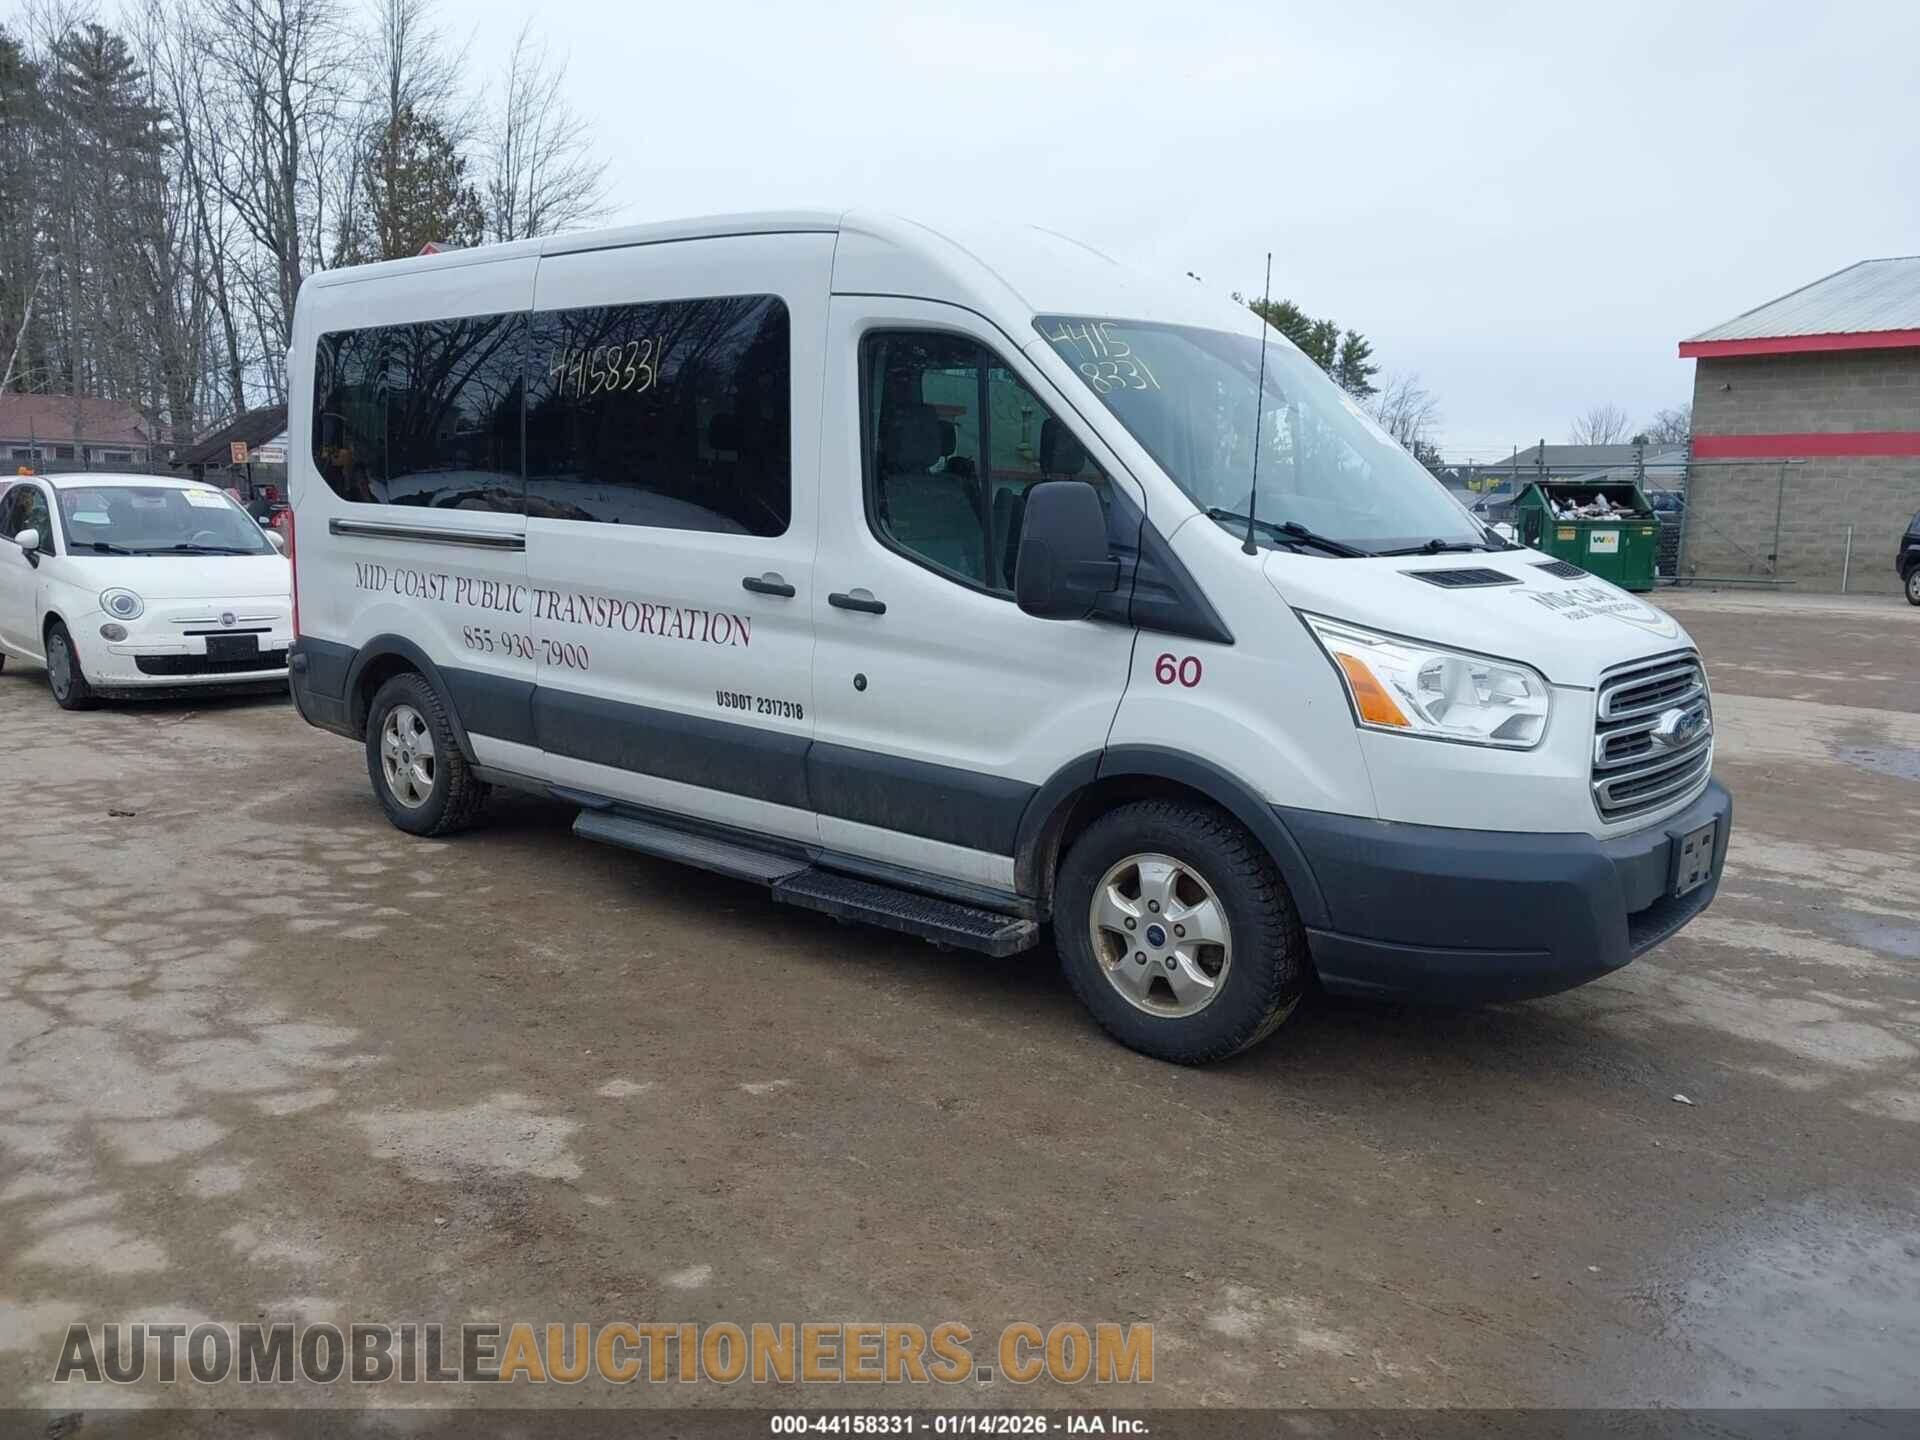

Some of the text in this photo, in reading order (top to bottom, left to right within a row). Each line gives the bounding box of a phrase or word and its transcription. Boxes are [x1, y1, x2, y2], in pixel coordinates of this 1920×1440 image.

[1039, 322, 1130, 359] 4415
[549, 335, 663, 399] 44158331
[1080, 355, 1161, 393] 8331
[355, 561, 751, 648] MID-COAST PUBLIC TRANSPORTATION
[463, 624, 590, 671] 855-930-7900
[1155, 653, 1202, 688] 60
[716, 689, 804, 720] USDOT 2317318
